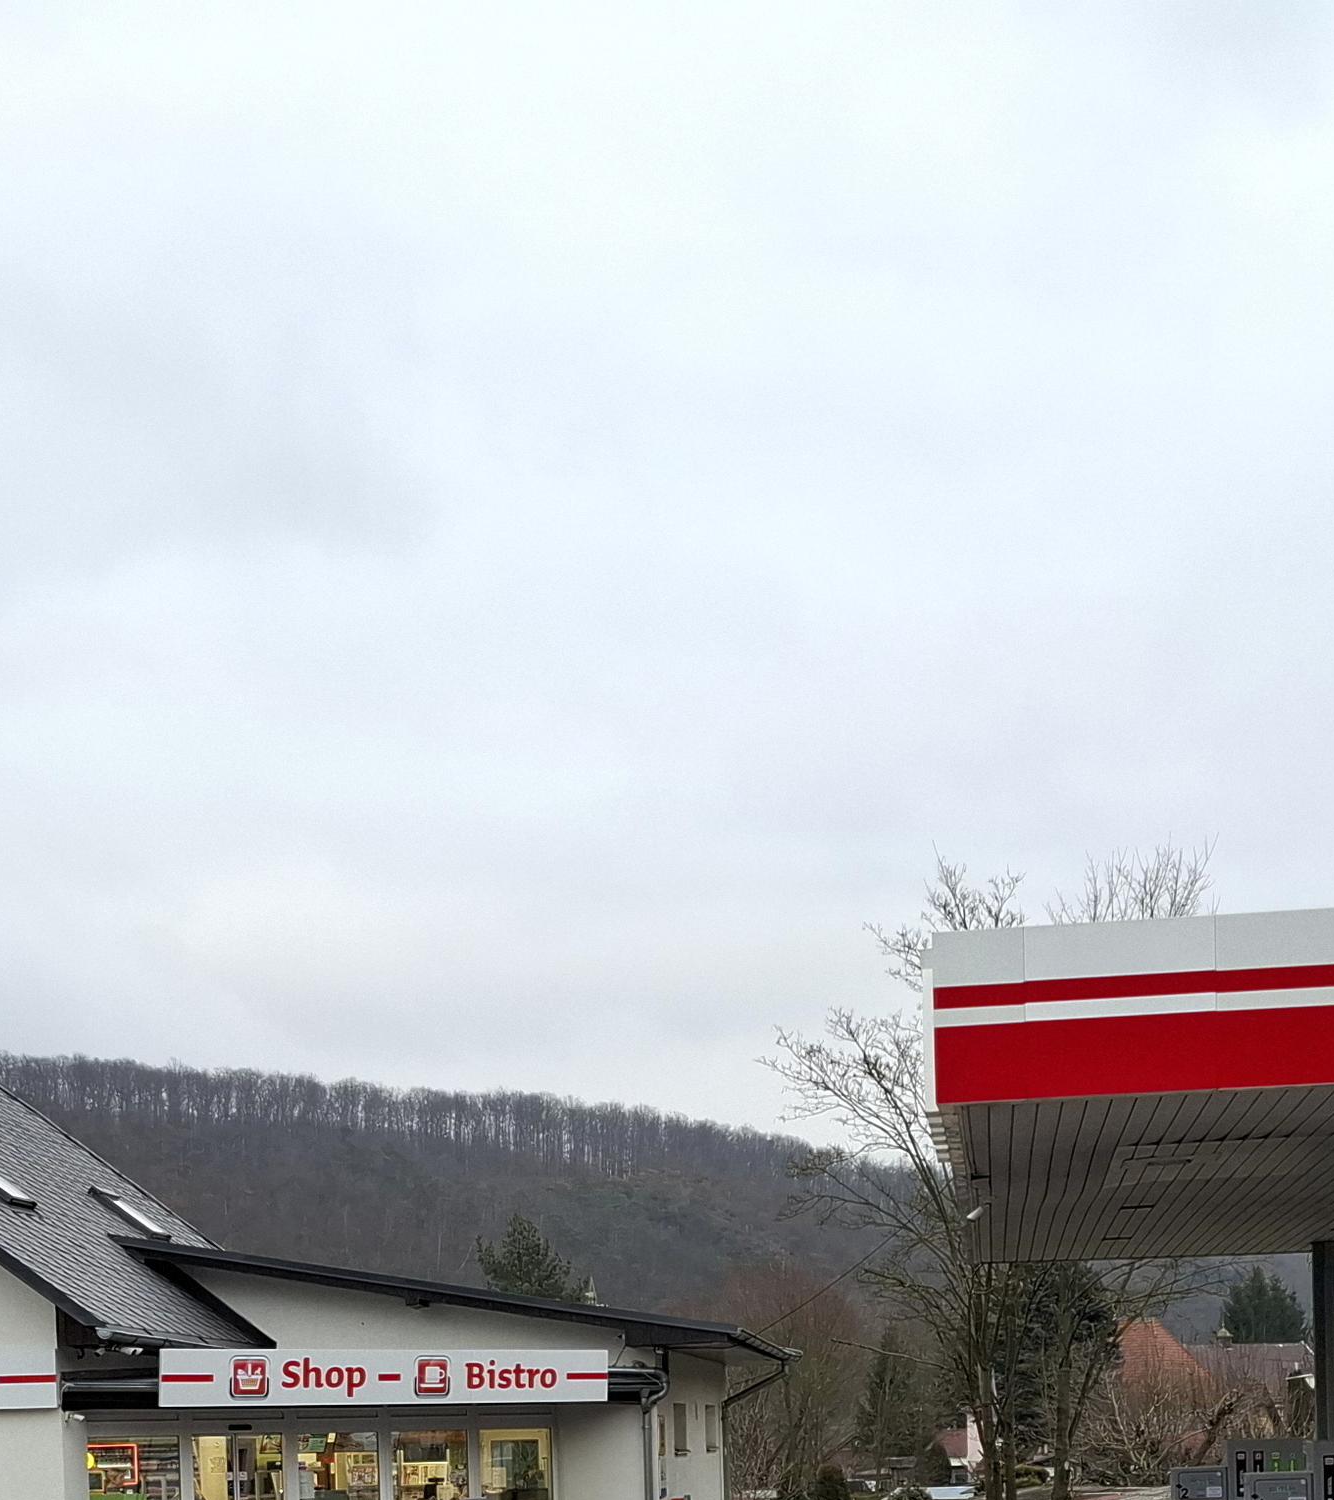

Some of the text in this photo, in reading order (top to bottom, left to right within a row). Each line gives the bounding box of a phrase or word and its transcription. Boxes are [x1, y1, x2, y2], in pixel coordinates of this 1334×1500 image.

[281, 1357, 558, 1398] Shop Bistro
[1180, 1488, 1189, 1499] 2
